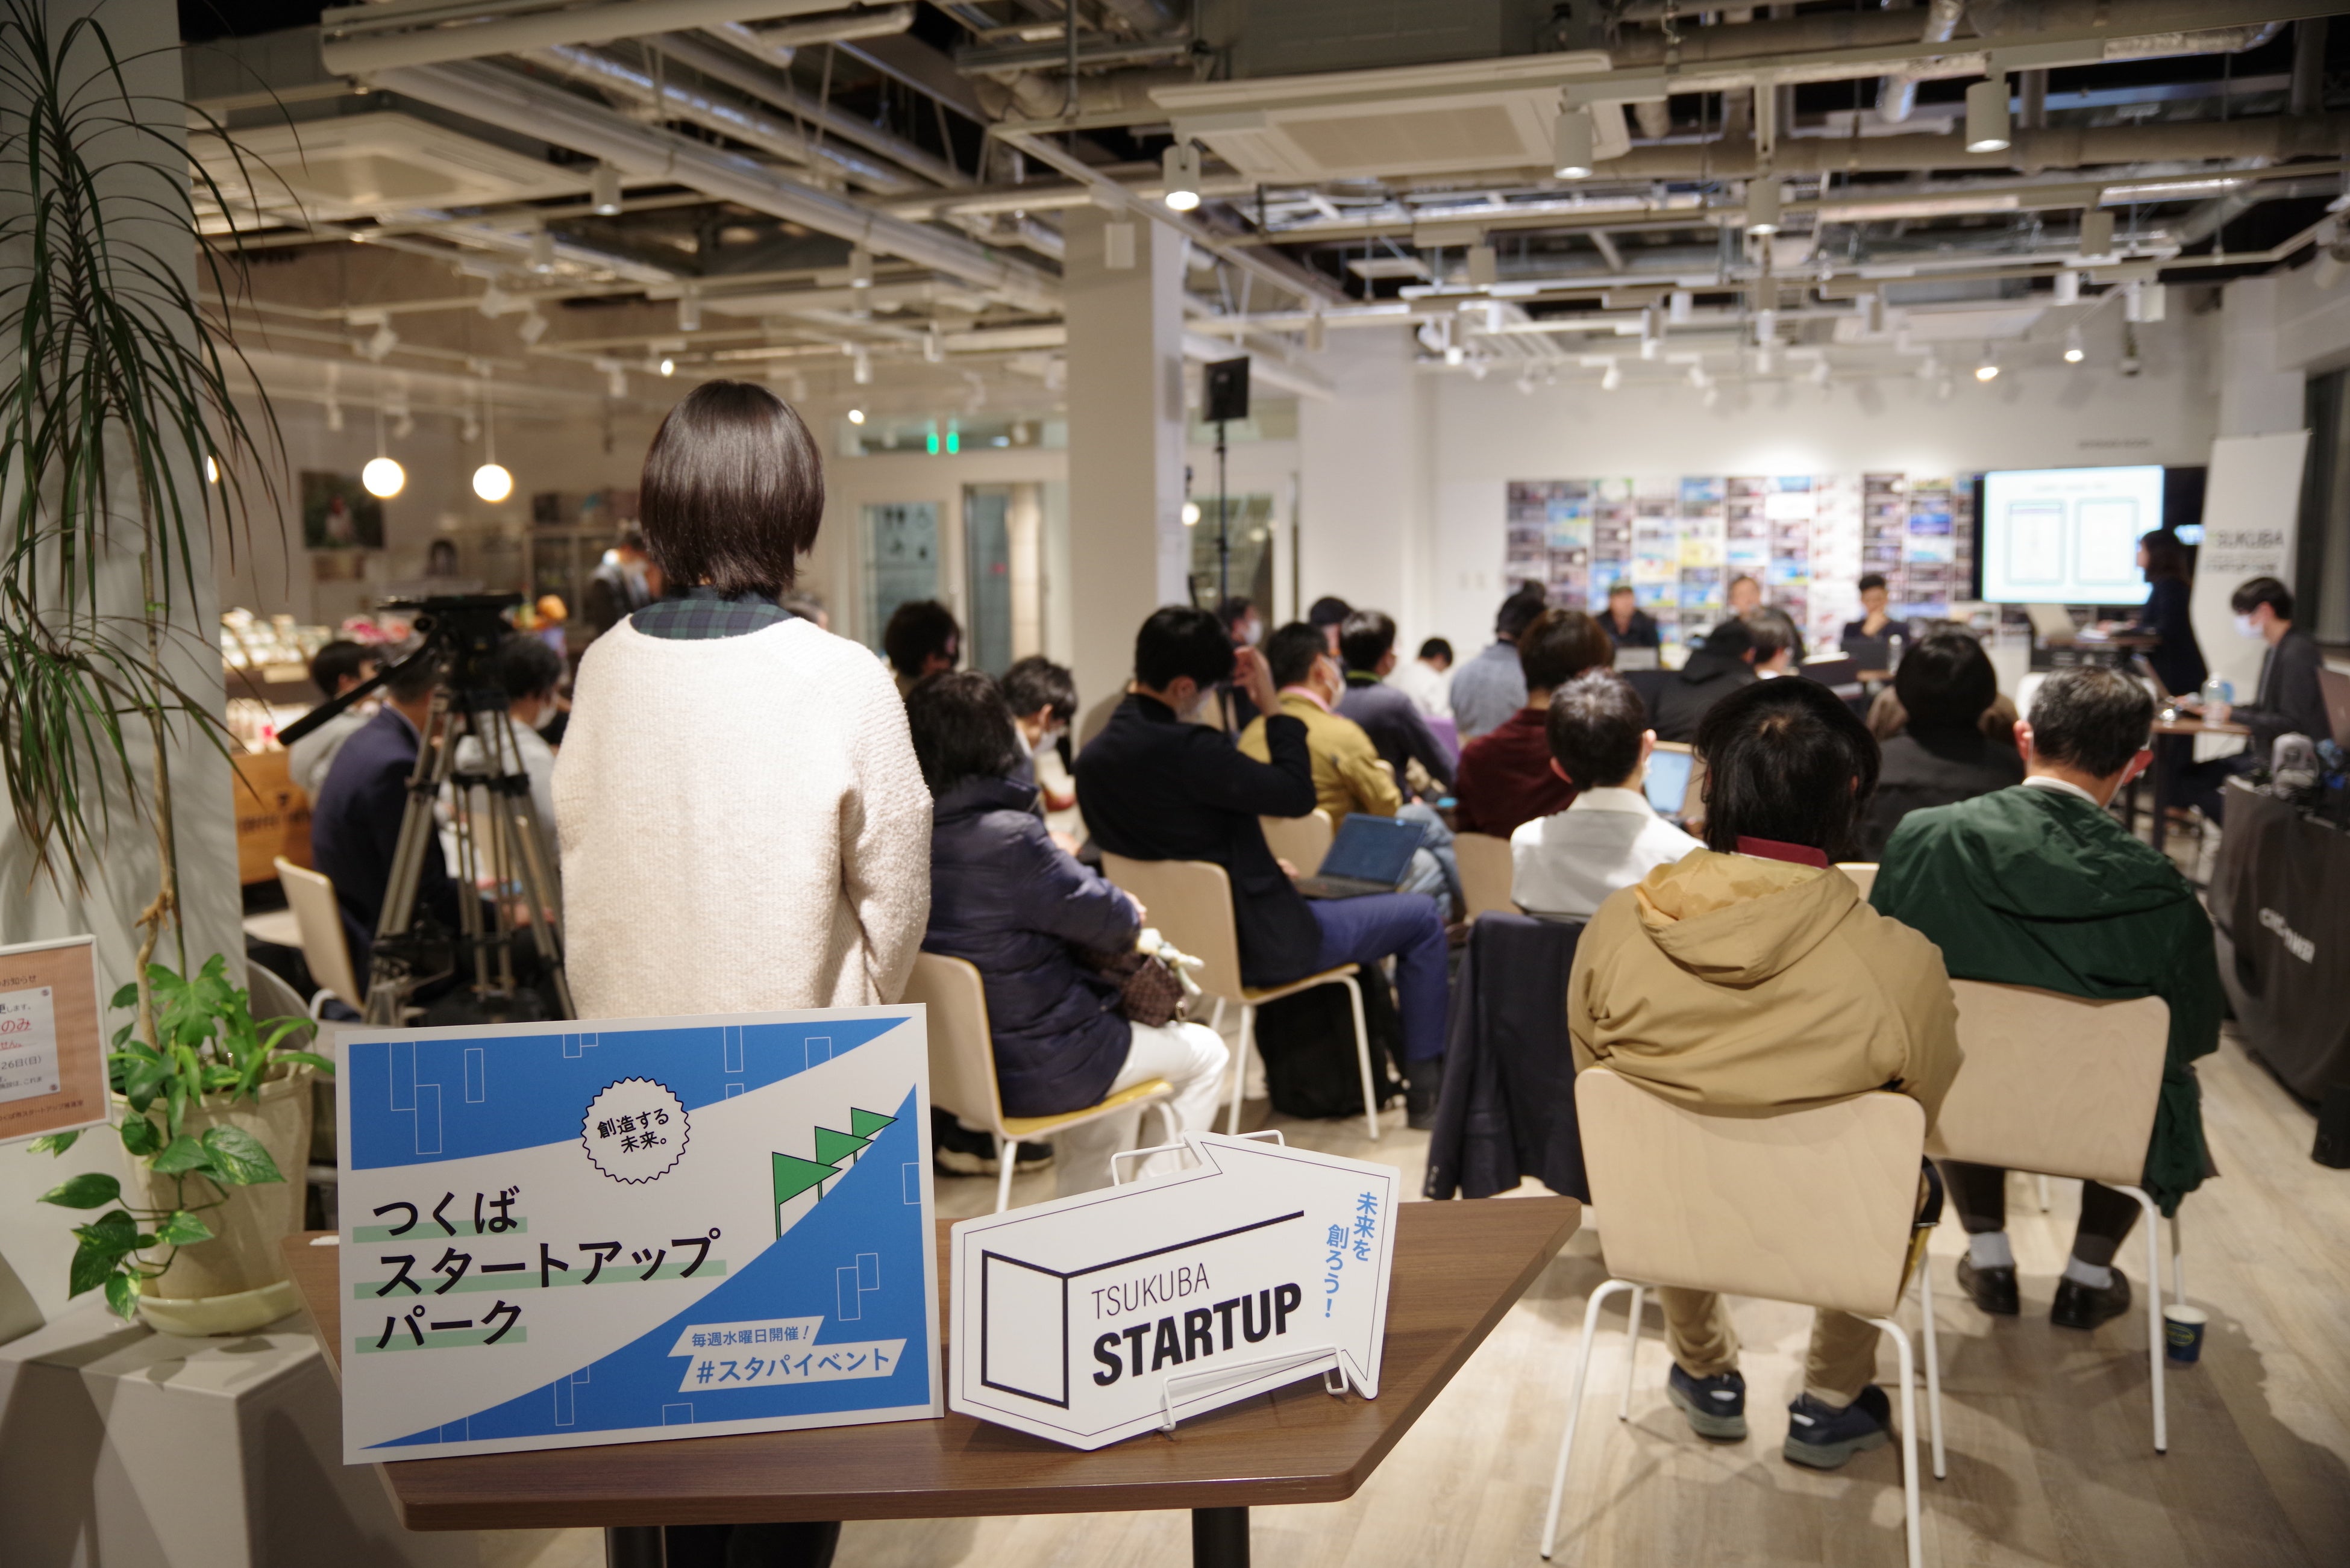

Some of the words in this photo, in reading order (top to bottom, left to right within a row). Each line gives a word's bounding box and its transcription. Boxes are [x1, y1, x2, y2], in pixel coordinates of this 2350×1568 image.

[597, 1108, 669, 1139] 創造する
[621, 1131, 667, 1154] 未来。
[373, 1185, 521, 1237] つくば
[1353, 1192, 1378, 1262] 未来を
[376, 1227, 721, 1297] スタートアップ
[1324, 1223, 1350, 1318] 創ろう！
[1091, 1263, 1210, 1319] TSUKUBA
[376, 1299, 522, 1349] パーク
[691, 1325, 810, 1348] 毎週水曜日開催！
[1093, 1282, 1302, 1387] STARTUP
[696, 1347, 889, 1384] #スタパイベント
